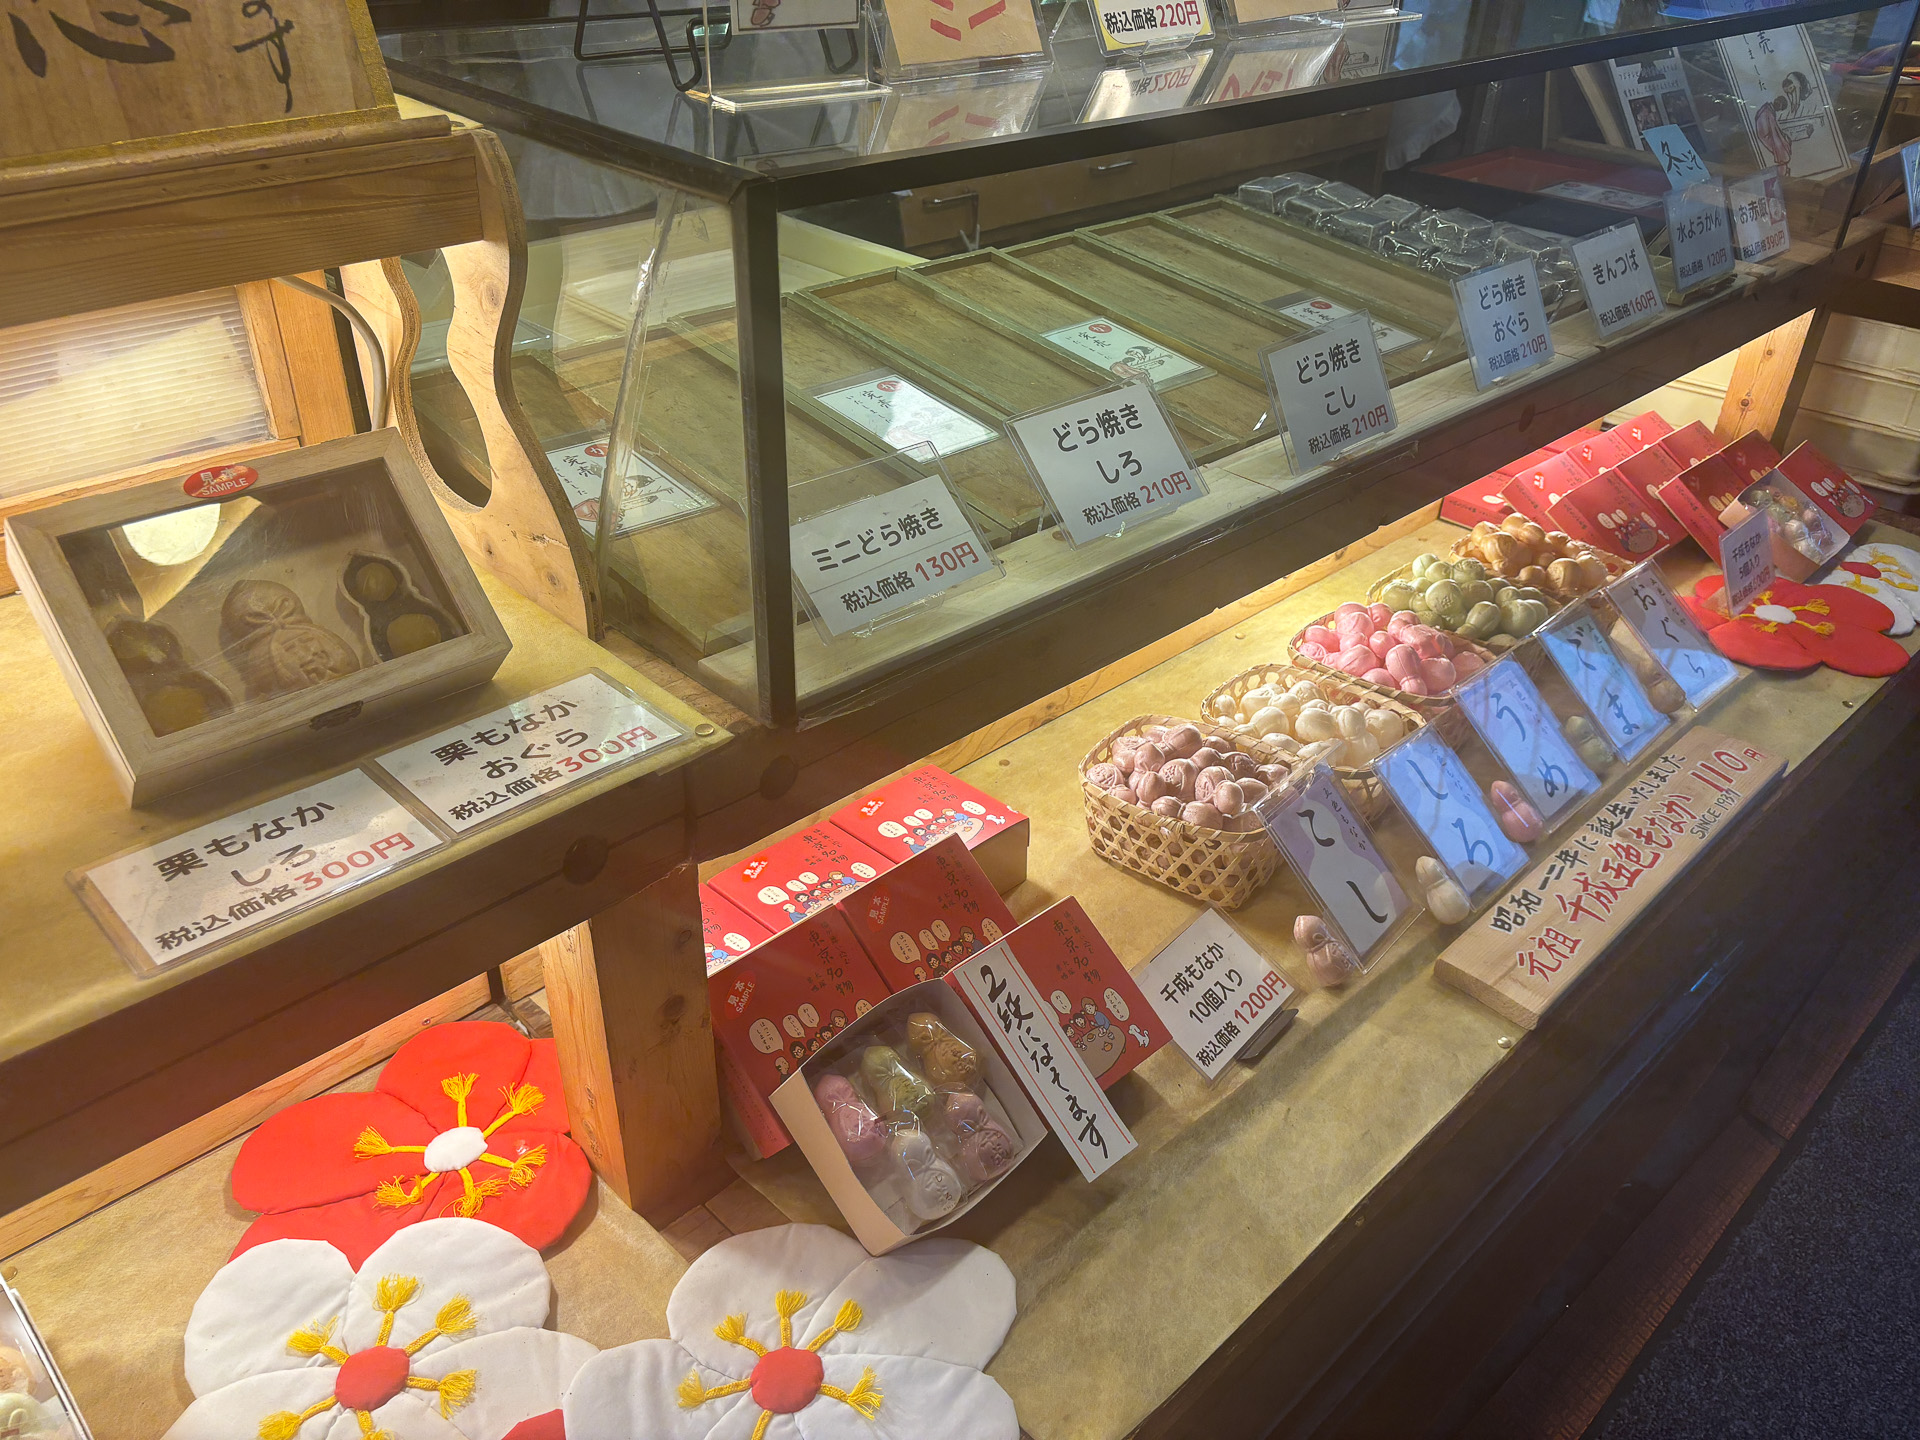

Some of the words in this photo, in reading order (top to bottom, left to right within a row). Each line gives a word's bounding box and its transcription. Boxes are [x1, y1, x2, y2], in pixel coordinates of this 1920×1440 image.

[1104, 0, 1201, 35] 税込価格220円
[1676, 207, 1722, 243] 水ようかん
[1592, 248, 1640, 286] きんつば
[1479, 274, 1527, 311] どら焼き
[1598, 289, 1658, 327] 税込価格160円
[1492, 311, 1530, 343] おぐら
[1296, 338, 1362, 385] どら焼き
[1325, 385, 1356, 417] こし
[1052, 403, 1143, 452] どら焼き
[200, 468, 237, 486] 見本
[201, 477, 249, 496] SAMPLE
[1096, 450, 1142, 484] しろ
[812, 506, 944, 573] ミニどら焼き
[1631, 583, 1705, 679] おぐら
[430, 698, 578, 766] 栗もなか
[479, 728, 590, 780] おぐら
[1490, 692, 1569, 798] うめ
[447, 724, 658, 822] 税込価格300円
[1406, 759, 1494, 867] しろ
[1689, 808, 1722, 841] SINCE
[156, 800, 335, 882] 栗もなか
[231, 843, 317, 886] しろ
[1296, 809, 1389, 924] こし
[156, 832, 416, 950] 税込価格300円
[869, 895, 882, 919] 見本
[878, 895, 890, 925] SAMPLE
[809, 929, 855, 996] 東京名物
[1053, 919, 1102, 985] 東京名物
[1159, 941, 1224, 1005] 千成もなか
[1517, 927, 1583, 983] 元祖
[727, 980, 746, 1007] 見本
[735, 981, 755, 1014] SAMPLE
[1188, 968, 1244, 1024] 10個入り
